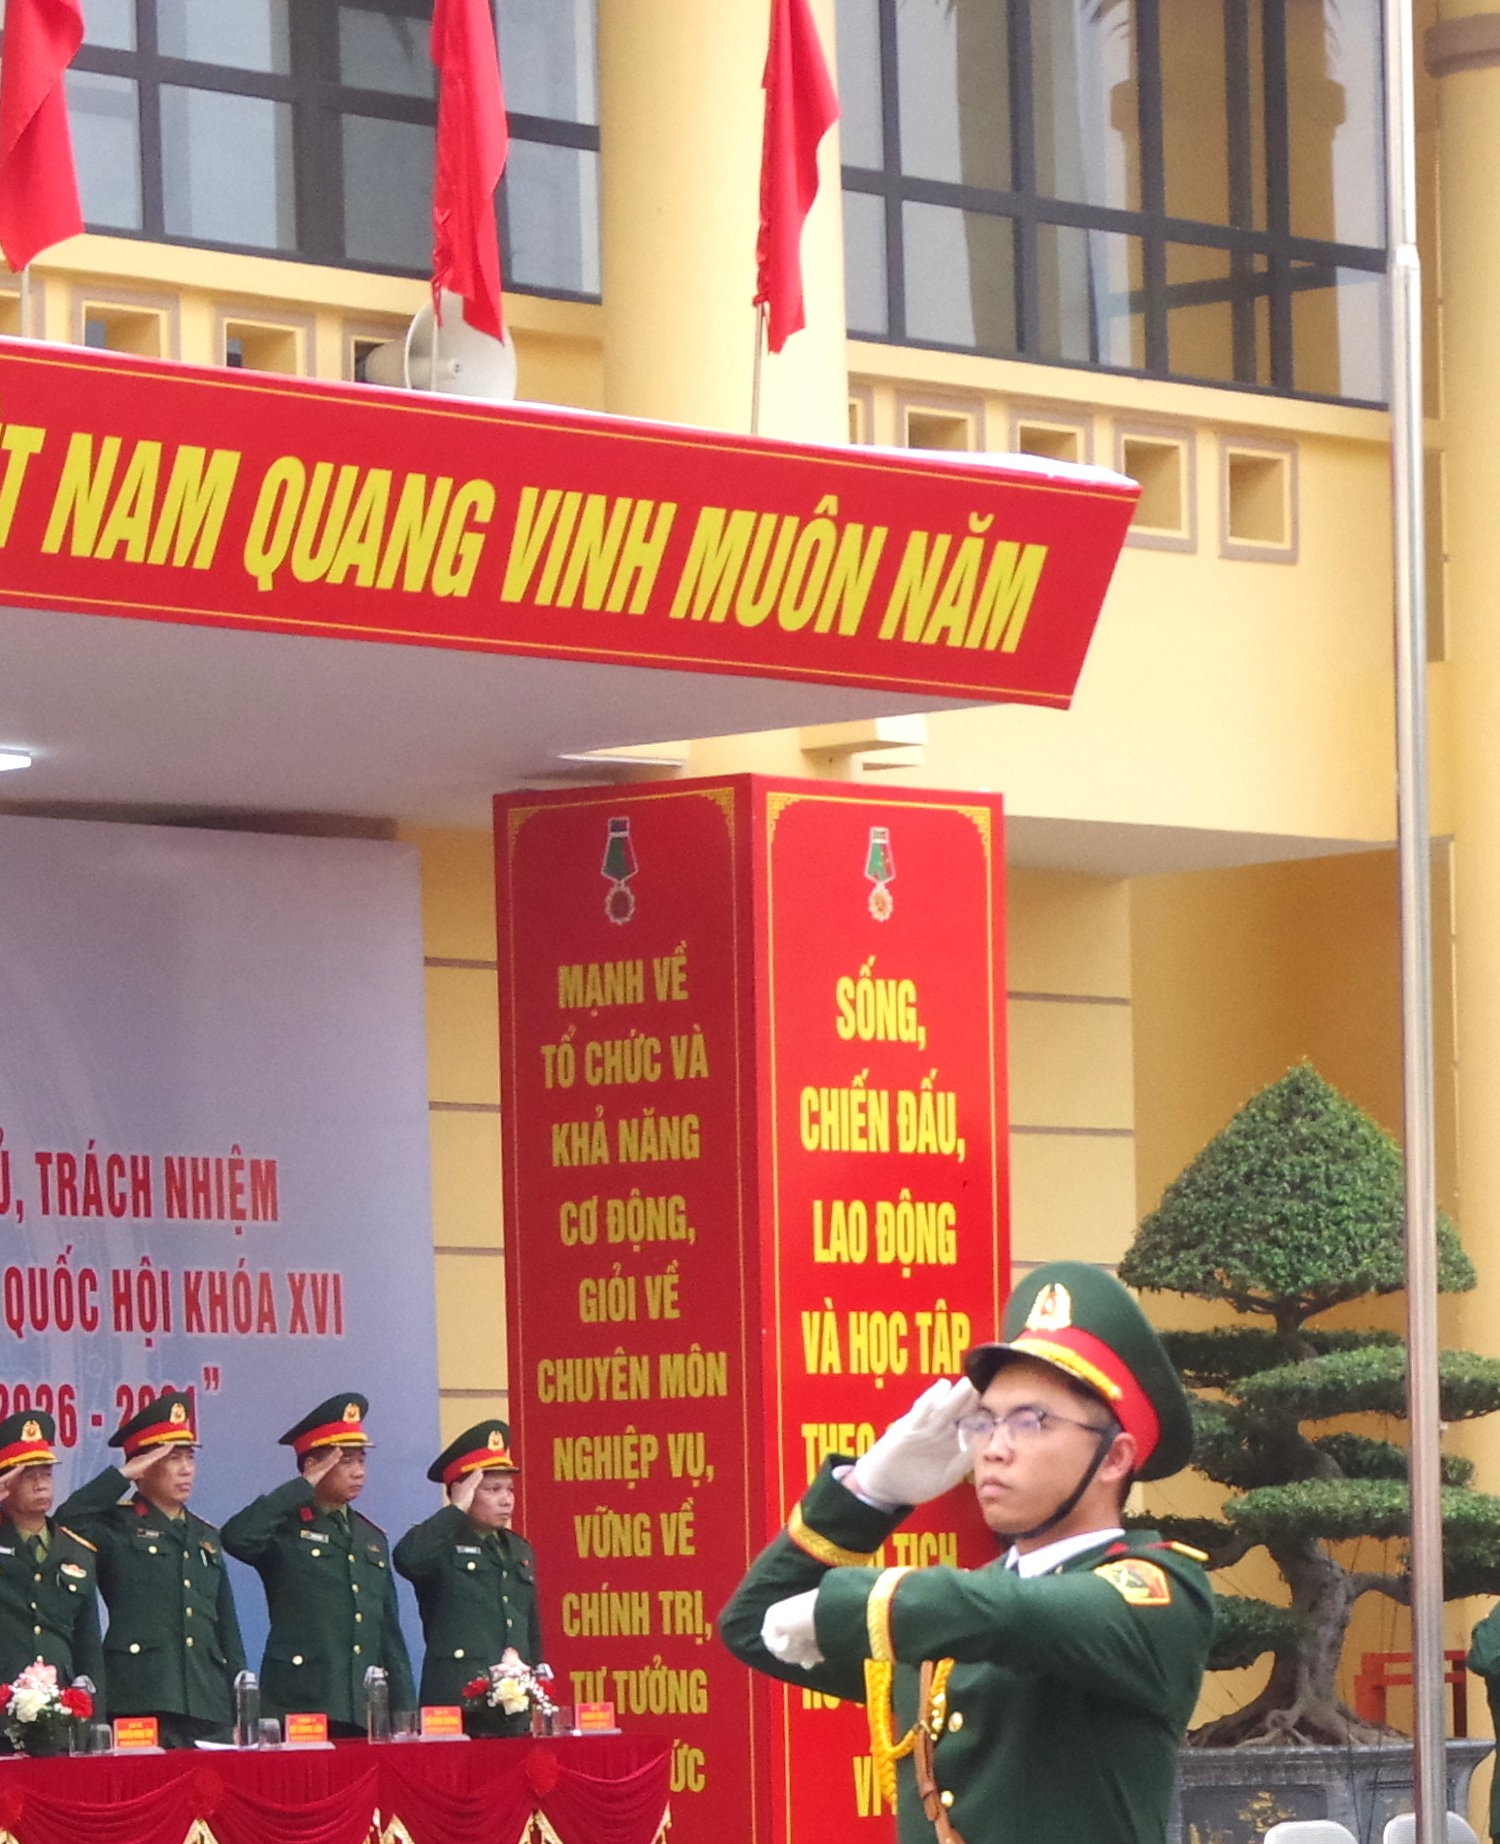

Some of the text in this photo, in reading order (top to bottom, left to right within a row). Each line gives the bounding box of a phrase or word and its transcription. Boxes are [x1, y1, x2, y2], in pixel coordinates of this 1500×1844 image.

[42, 433, 241, 569] NAM
[244, 457, 495, 597] QUANG
[501, 487, 660, 614] VINH
[670, 495, 887, 639] MUÔN
[879, 513, 1047, 652] NĂM
[560, 939, 687, 1017] MẠNH VỀ
[836, 956, 926, 1050] SỐNG,
[586, 1028, 660, 1085] CHỨC
[672, 1023, 708, 1079] VÀ
[553, 1105, 699, 1165] KHẢ NĂNG
[800, 1069, 965, 1161] CHIẾN ĐẤU,
[34, 1140, 154, 1219] TRÁCH
[164, 1144, 279, 1235] NHIỆM
[561, 1190, 695, 1253] CƠ ĐỘNG,
[813, 1188, 956, 1277] LAO ĐỘNG
[3, 1246, 100, 1339] QUỐC
[111, 1256, 172, 1354] HỘI
[183, 1259, 278, 1334] KHÓA
[287, 1273, 344, 1335] XVI
[580, 1259, 680, 1322] GIỎI VỀ
[538, 1344, 727, 1402] CHUYÊN MÔN
[802, 1298, 842, 1374] VÀ
[849, 1311, 908, 1388] HỌC
[116, 1367, 221, 1441] 21”
[554, 1427, 714, 1488] NGHIỆP VỤ,
[575, 1500, 695, 1557] VỮNG VỀ
[563, 1583, 712, 1644] CHÍNH TRỊ,
[571, 1656, 707, 1714] TƯ TƯỞNG
[670, 1738, 705, 1792] ỨC
